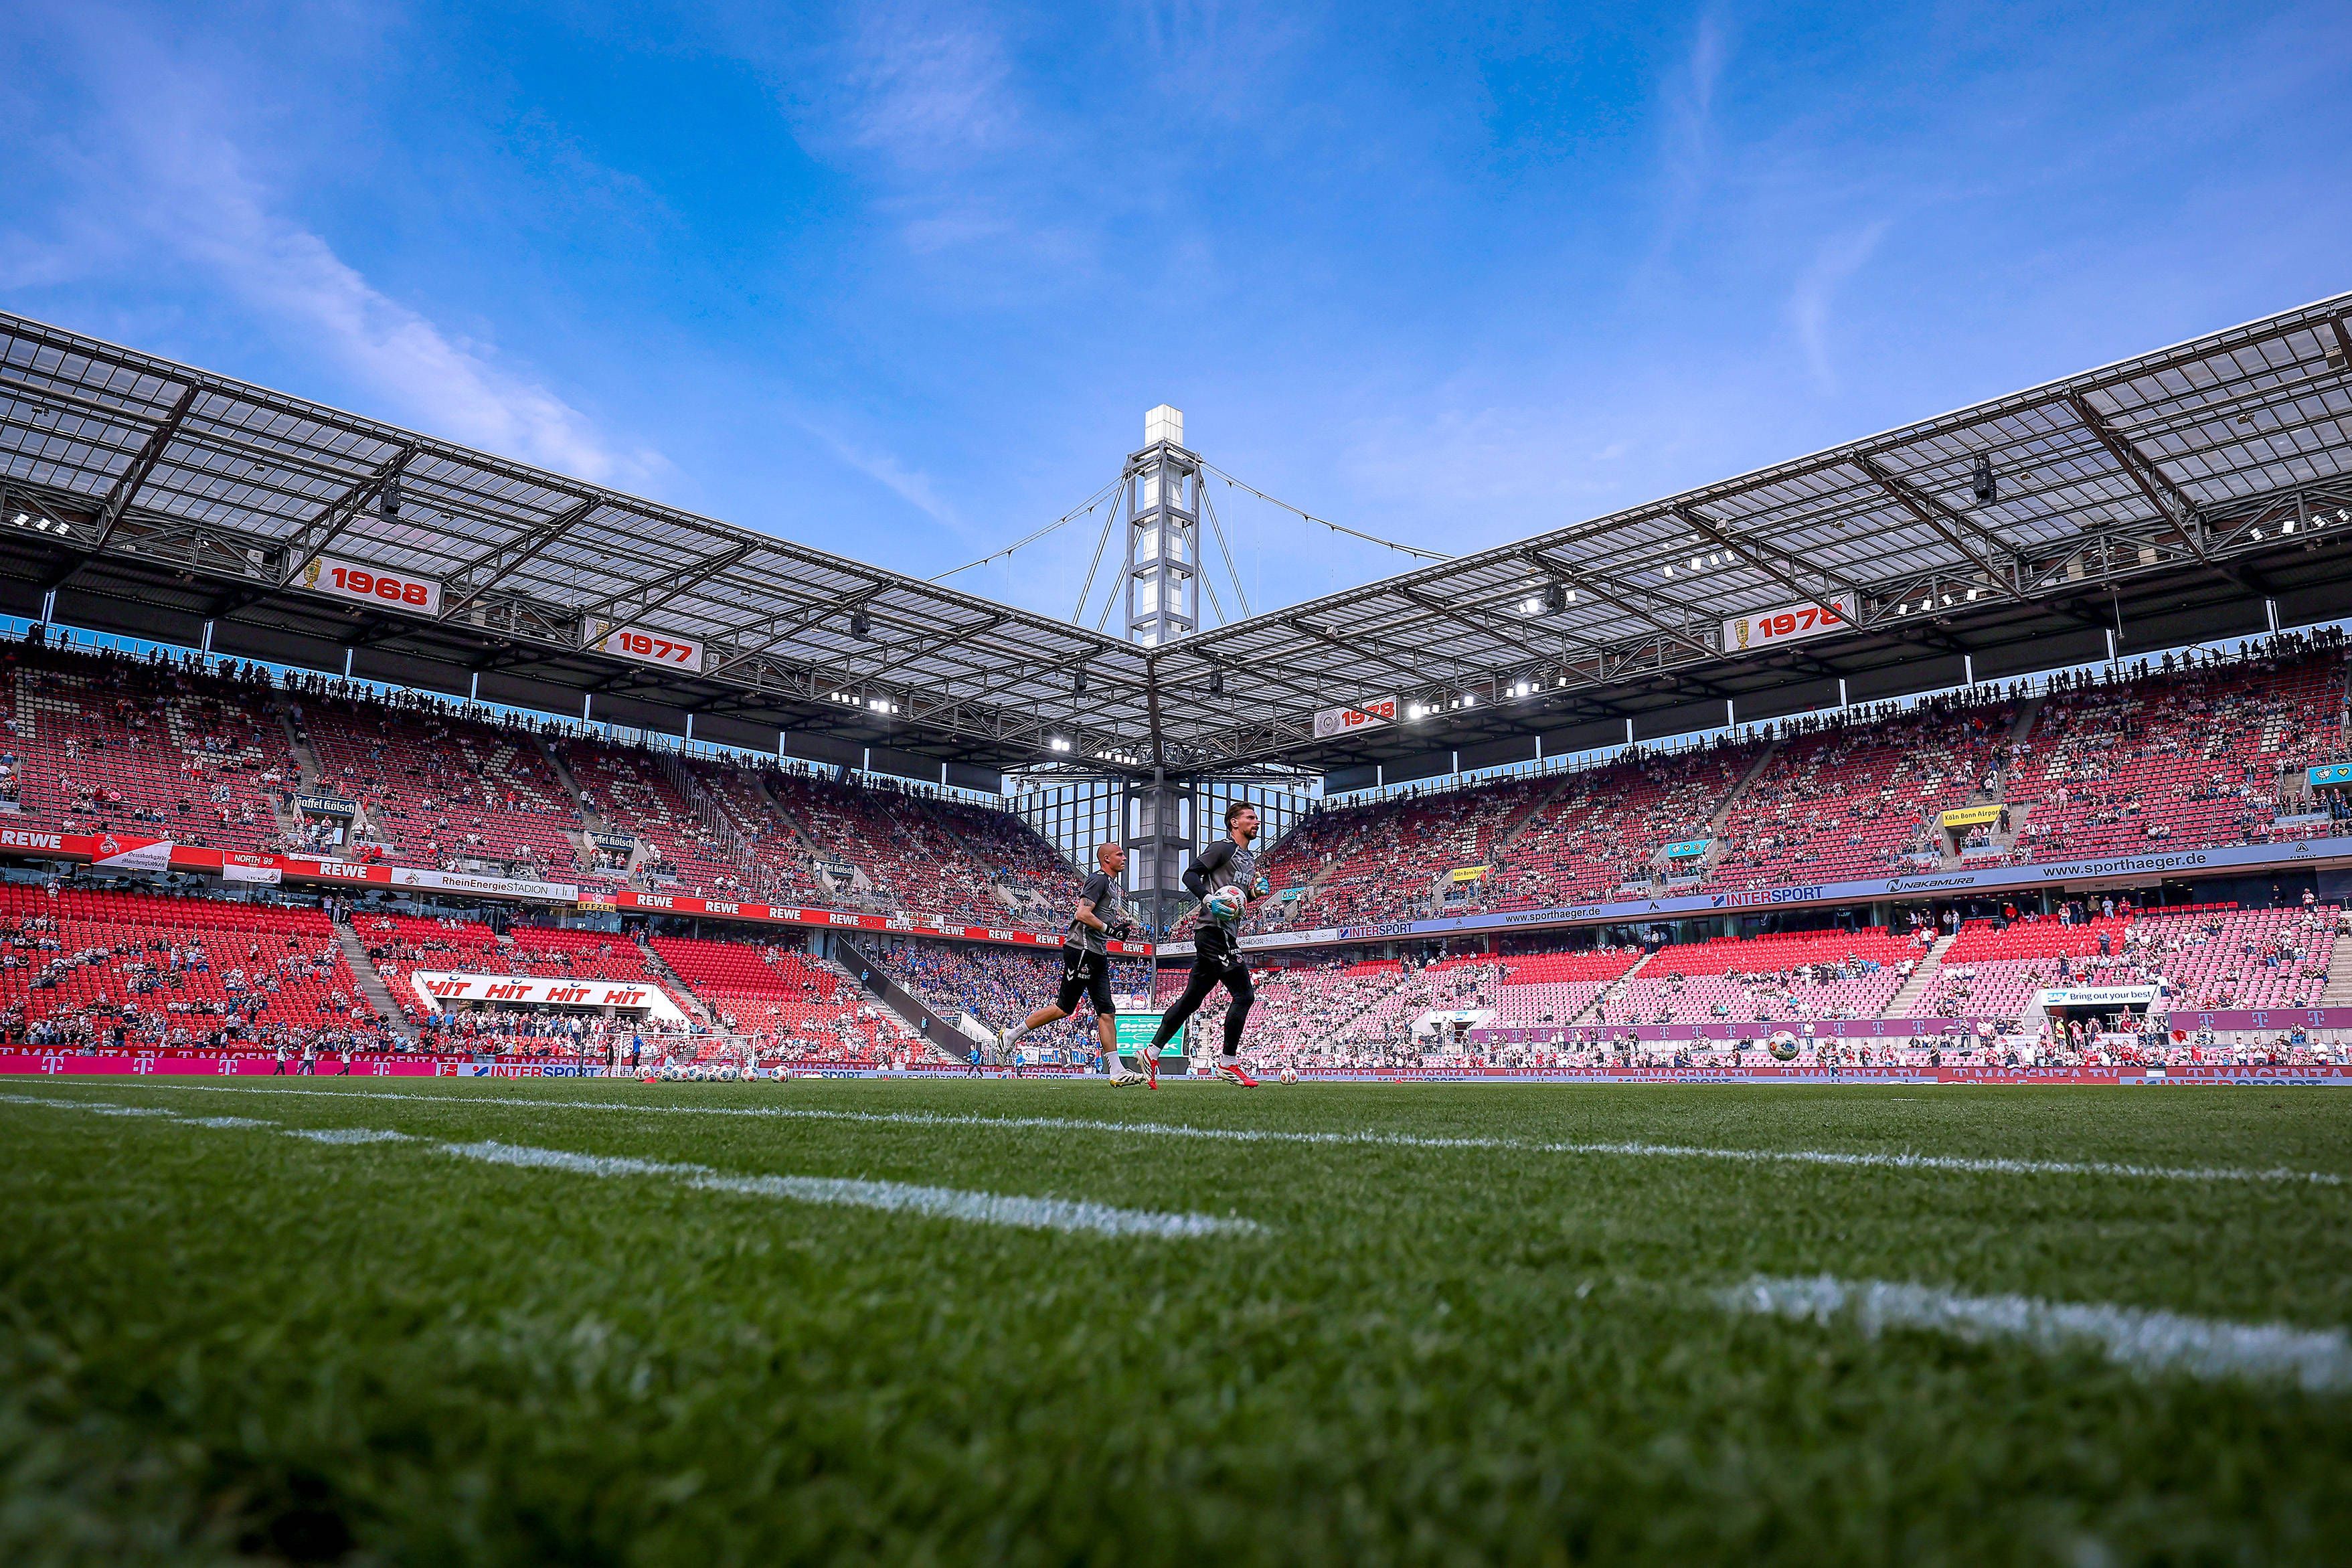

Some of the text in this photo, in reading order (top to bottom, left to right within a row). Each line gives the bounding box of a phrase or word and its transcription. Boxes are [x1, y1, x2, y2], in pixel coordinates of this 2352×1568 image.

[331, 567, 428, 606] 1968
[1759, 603, 1842, 638] 1978
[619, 632, 693, 663] 1977
[1342, 702, 1394, 727] 1978
[324, 800, 355, 814] Kölsch
[1, 831, 62, 849] REWE
[610, 836, 634, 849] Kölsch
[234, 855, 260, 863] NORTH
[2043, 853, 2207, 875] www.sporthaeger.de
[320, 863, 367, 879] REWE
[442, 876, 548, 895] RheinEnergieSTADION
[1233, 870, 1254, 887] REW
[584, 886, 613, 895] ALLEZ
[1726, 886, 1823, 906] INTERSPORT
[580, 903, 616, 911] EFFZEH!
[637, 894, 673, 908] REWE
[705, 901, 739, 914] REWE
[769, 907, 801, 920] REWE
[829, 913, 859, 926] REWE
[1505, 907, 1601, 923] www.sporthaeger.de
[938, 925, 965, 936] REWE
[989, 930, 1014, 941] REWE
[1349, 923, 1413, 938] INTERSPORT
[1035, 934, 1060, 945] REWE
[1122, 942, 1145, 954] REWE
[485, 983, 533, 999] HIT
[545, 986, 591, 1002] HIT
[603, 990, 646, 1005] HIT
[2070, 993, 2092, 1001] Bring
[2109, 992, 2130, 1000] your
[491, 1065, 597, 1077] INTERSPORT
